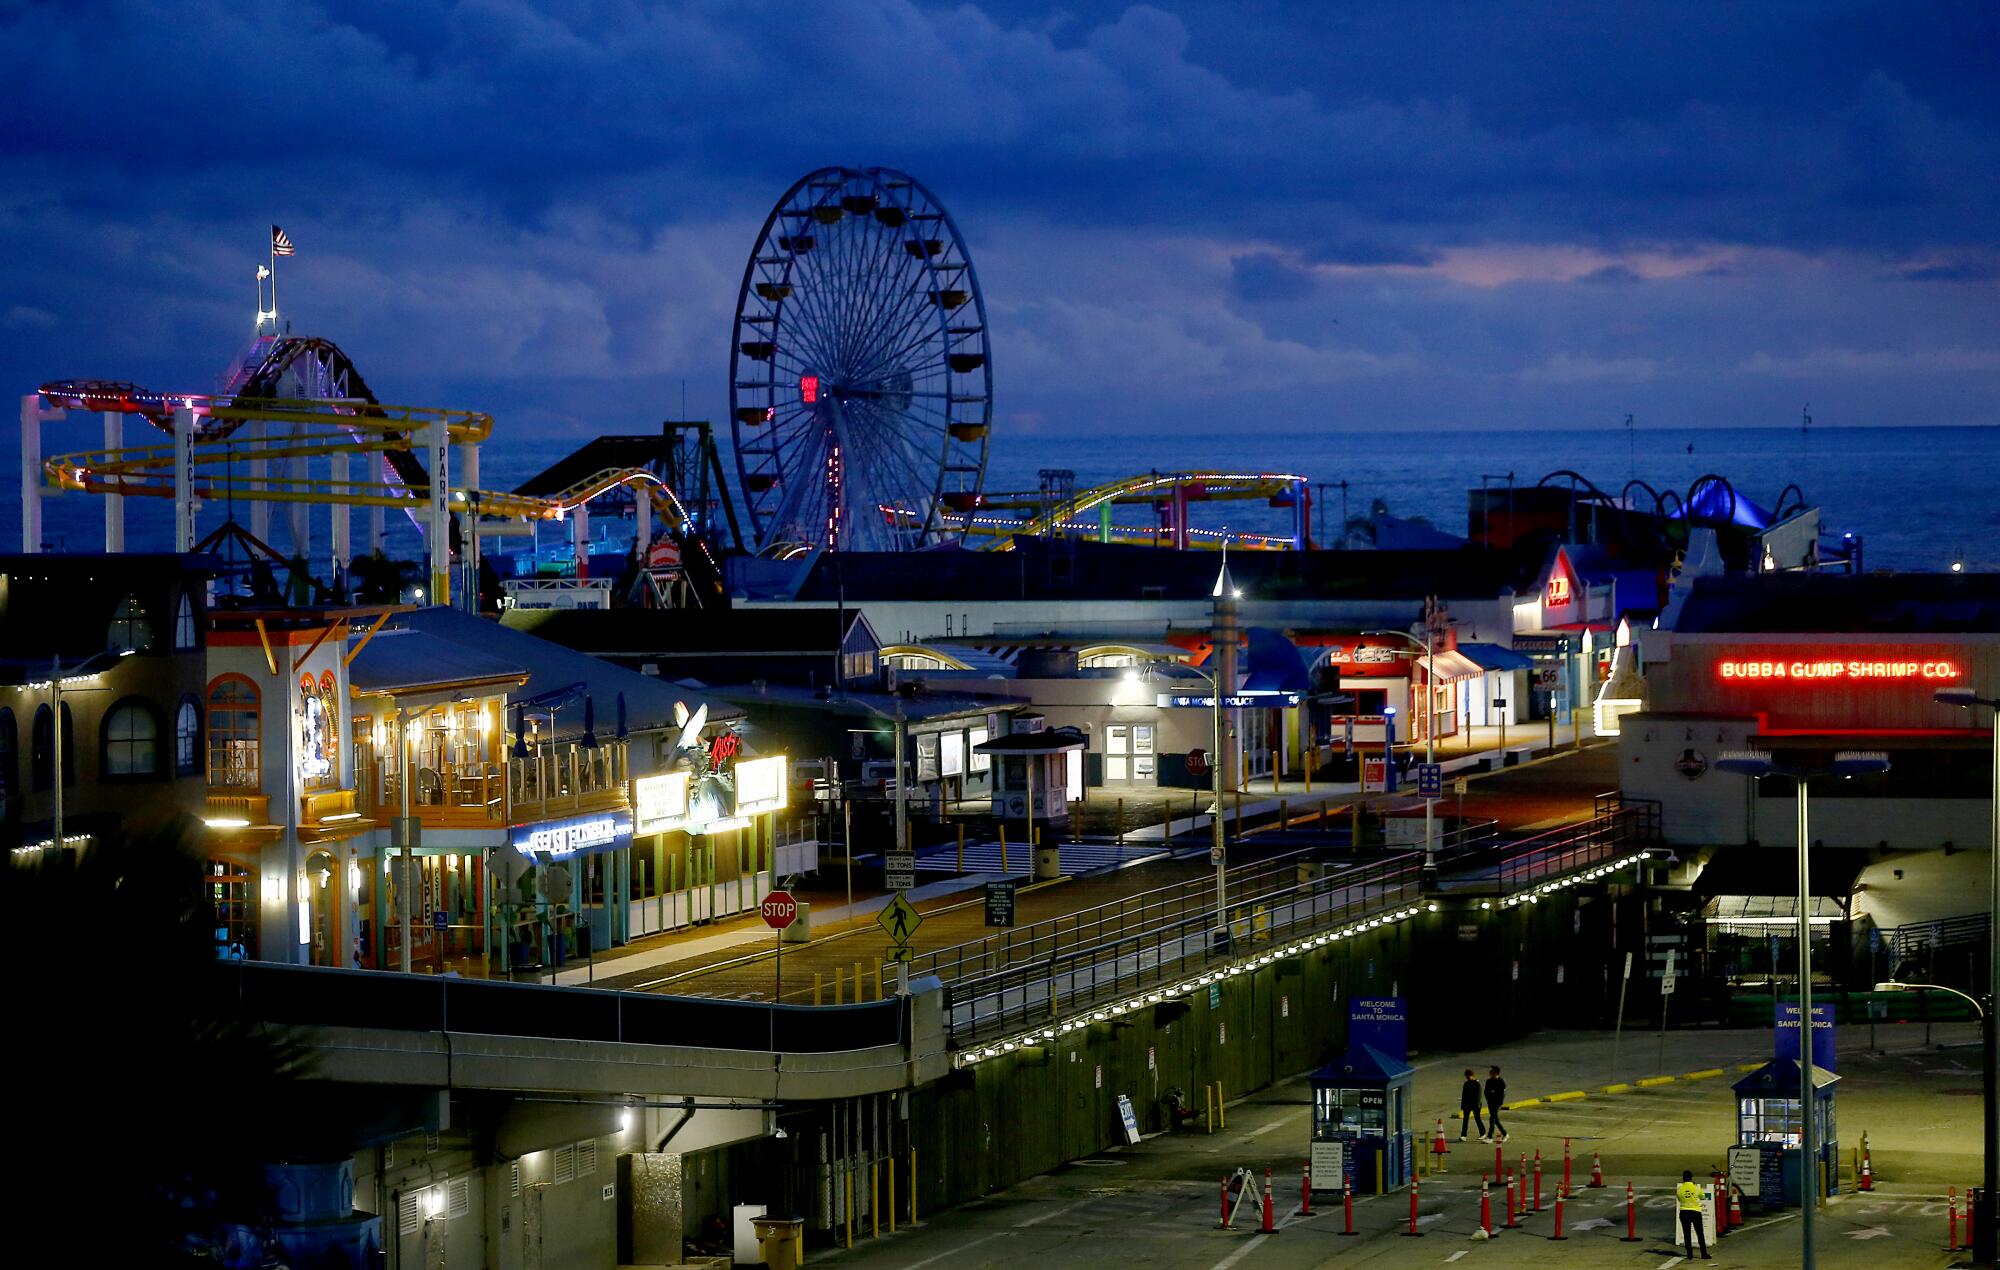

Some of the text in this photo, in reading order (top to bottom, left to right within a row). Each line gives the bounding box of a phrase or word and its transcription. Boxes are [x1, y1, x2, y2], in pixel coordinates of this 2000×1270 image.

[1722, 662, 1957, 678] BUBBA GUMP SHRIMP CO.
[1543, 670, 1557, 682] 66
[1225, 697, 1255, 707] POLICE
[1187, 756, 1206, 768] STO
[763, 902, 795, 917] STOP
[1360, 1000, 1396, 1008] WELCOME
[1351, 1013, 1405, 1021] SANTA MONICA
[1807, 1021, 1833, 1029] ONICA
[1362, 1096, 1383, 1104] OPEN
